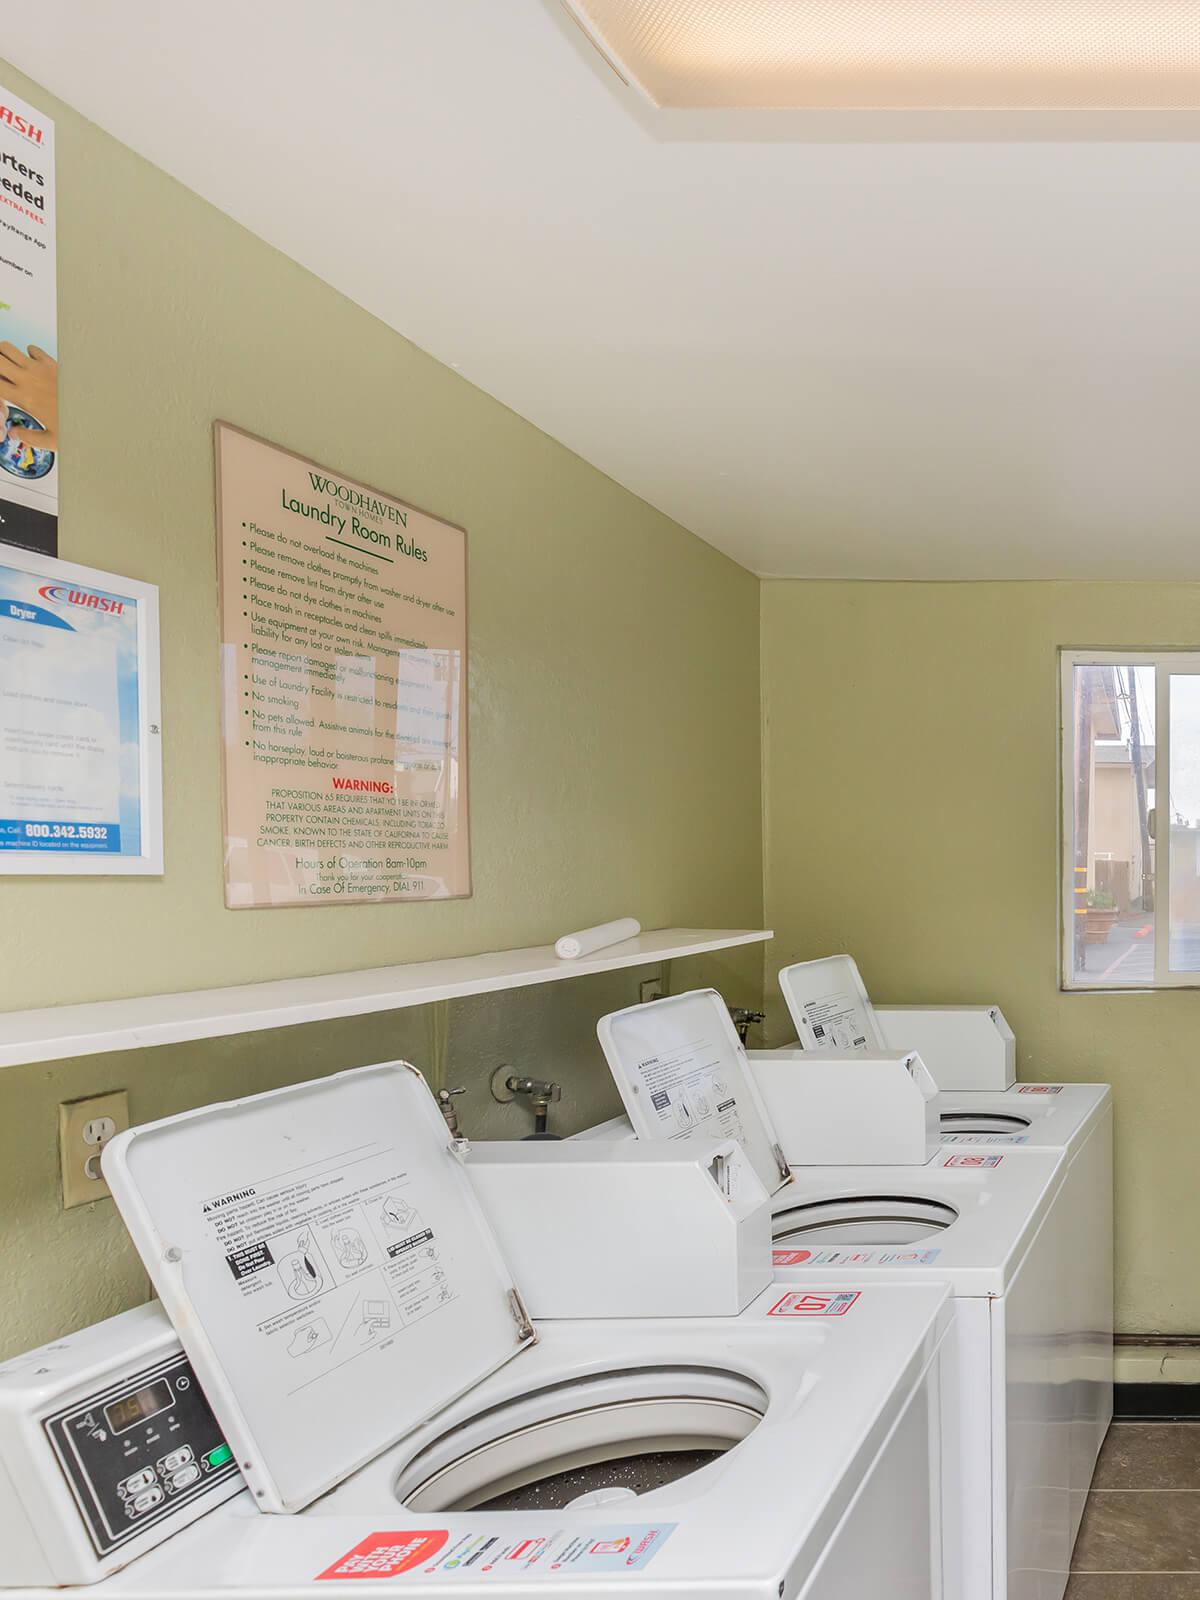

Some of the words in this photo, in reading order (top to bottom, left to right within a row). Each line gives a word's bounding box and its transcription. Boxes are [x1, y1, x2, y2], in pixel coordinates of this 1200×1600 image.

[0, 152, 44, 186] rters
[0, 177, 44, 210] eded
[308, 472, 407, 528] WOODHAVEN
[336, 500, 357, 515] TOWN
[282, 488, 346, 537] Laundry
[352, 516, 391, 549] Room
[396, 533, 428, 562] Rules
[250, 522, 275, 540] Please
[277, 532, 288, 544] do
[290, 539, 301, 549] not
[304, 544, 335, 560] overload
[337, 553, 347, 564] the
[250, 541, 276, 559] Please
[278, 554, 305, 568] remove
[307, 561, 331, 576] clothes
[333, 572, 362, 589] promptly
[364, 578, 378, 592] from
[380, 587, 401, 599] washer
[403, 594, 414, 603] and
[416, 596, 431, 609] dryer
[432, 602, 445, 613] after
[250, 559, 275, 576] Please
[278, 571, 305, 585] remove
[307, 577, 318, 589] lint
[320, 581, 336, 594] from
[338, 586, 355, 600] dryer
[357, 594, 372, 605] after
[374, 600, 384, 609] use
[68, 590, 123, 615] WASH
[250, 576, 275, 593] Please
[277, 584, 288, 596] do
[290, 592, 301, 600] not
[303, 592, 317, 606] dye
[319, 598, 342, 612] clothes
[344, 606, 351, 614] in
[353, 610, 382, 623] machines
[10, 604, 37, 620] Dryer
[251, 594, 272, 609] Place
[275, 602, 293, 614] trash
[295, 608, 302, 617] in
[304, 612, 343, 628] receptacles
[345, 622, 358, 632] and
[359, 625, 376, 637] clean
[379, 631, 393, 641] spills
[251, 611, 266, 624] Use
[268, 620, 308, 634] equipment
[319, 632, 334, 641] your
[336, 637, 351, 645] own
[251, 624, 280, 642] liability
[282, 631, 292, 643] for
[295, 638, 309, 649] any
[311, 638, 323, 650] lost
[334, 646, 352, 657] stolen
[251, 643, 276, 657] Please
[279, 652, 302, 663] report
[304, 655, 337, 671] damaged
[252, 658, 302, 674] management
[304, 668, 345, 685] immediately
[252, 674, 266, 685] Use
[269, 678, 278, 687] of
[279, 679, 310, 696] Laundry
[312, 685, 335, 700] Facility
[252, 691, 264, 702] No
[268, 697, 299, 709] smoking
[252, 710, 265, 720] No
[268, 715, 284, 723] pets
[319, 720, 347, 732] Assistive
[348, 727, 373, 736] animals
[375, 729, 384, 738] for
[385, 731, 394, 740] the
[252, 720, 271, 732] from
[274, 724, 286, 734] this
[253, 740, 265, 750] No
[309, 747, 325, 757] loud
[336, 750, 368, 762] boisterous
[370, 756, 394, 766] profane
[254, 754, 306, 766] inappropriate
[272, 789, 323, 800] PROPOSITION
[325, 793, 333, 801] 65
[336, 794, 368, 804] REQUIRES
[370, 796, 385, 805] THAT
[332, 778, 394, 794] WARNING:
[266, 801, 285, 810] THAT
[288, 802, 322, 812] VARIOUS
[323, 805, 346, 813] AREAS
[348, 806, 363, 814] AND
[366, 807, 401, 816] APARTMENT
[403, 810, 420, 818] UNITS
[266, 814, 304, 823] PROPERTY
[306, 816, 340, 825] CONTAIN
[383, 820, 417, 828] INCLUDING
[25, 823, 108, 840] 800.342.5932
[294, 827, 326, 836] KNOWN
[328, 828, 337, 836] TO
[340, 829, 351, 837] THE
[353, 829, 371, 838] STATE
[374, 830, 383, 838] OF
[385, 830, 420, 839] CALIFORNIA
[295, 839, 315, 848] BIRTH
[317, 840, 347, 848] DEFECTS
[348, 840, 364, 849] AND
[366, 841, 386, 849] OTHER
[388, 842, 431, 850] REPRODUCTIVE
[296, 858, 324, 868] Hours
[327, 858, 336, 868] of
[338, 858, 383, 870] Operation
[386, 858, 427, 870] 8am-10pm
[298, 884, 306, 894] In
[310, 884, 331, 894] Case
[333, 883, 345, 893] Of
[348, 883, 391, 895] Emergency,
[393, 882, 410, 891] DIAL
[413, 882, 424, 891] 911
[318, 873, 336, 881] Thank
[351, 873, 359, 881] for
[211, 1188, 256, 1209] WARNING
[794, 1295, 832, 1311] 07
